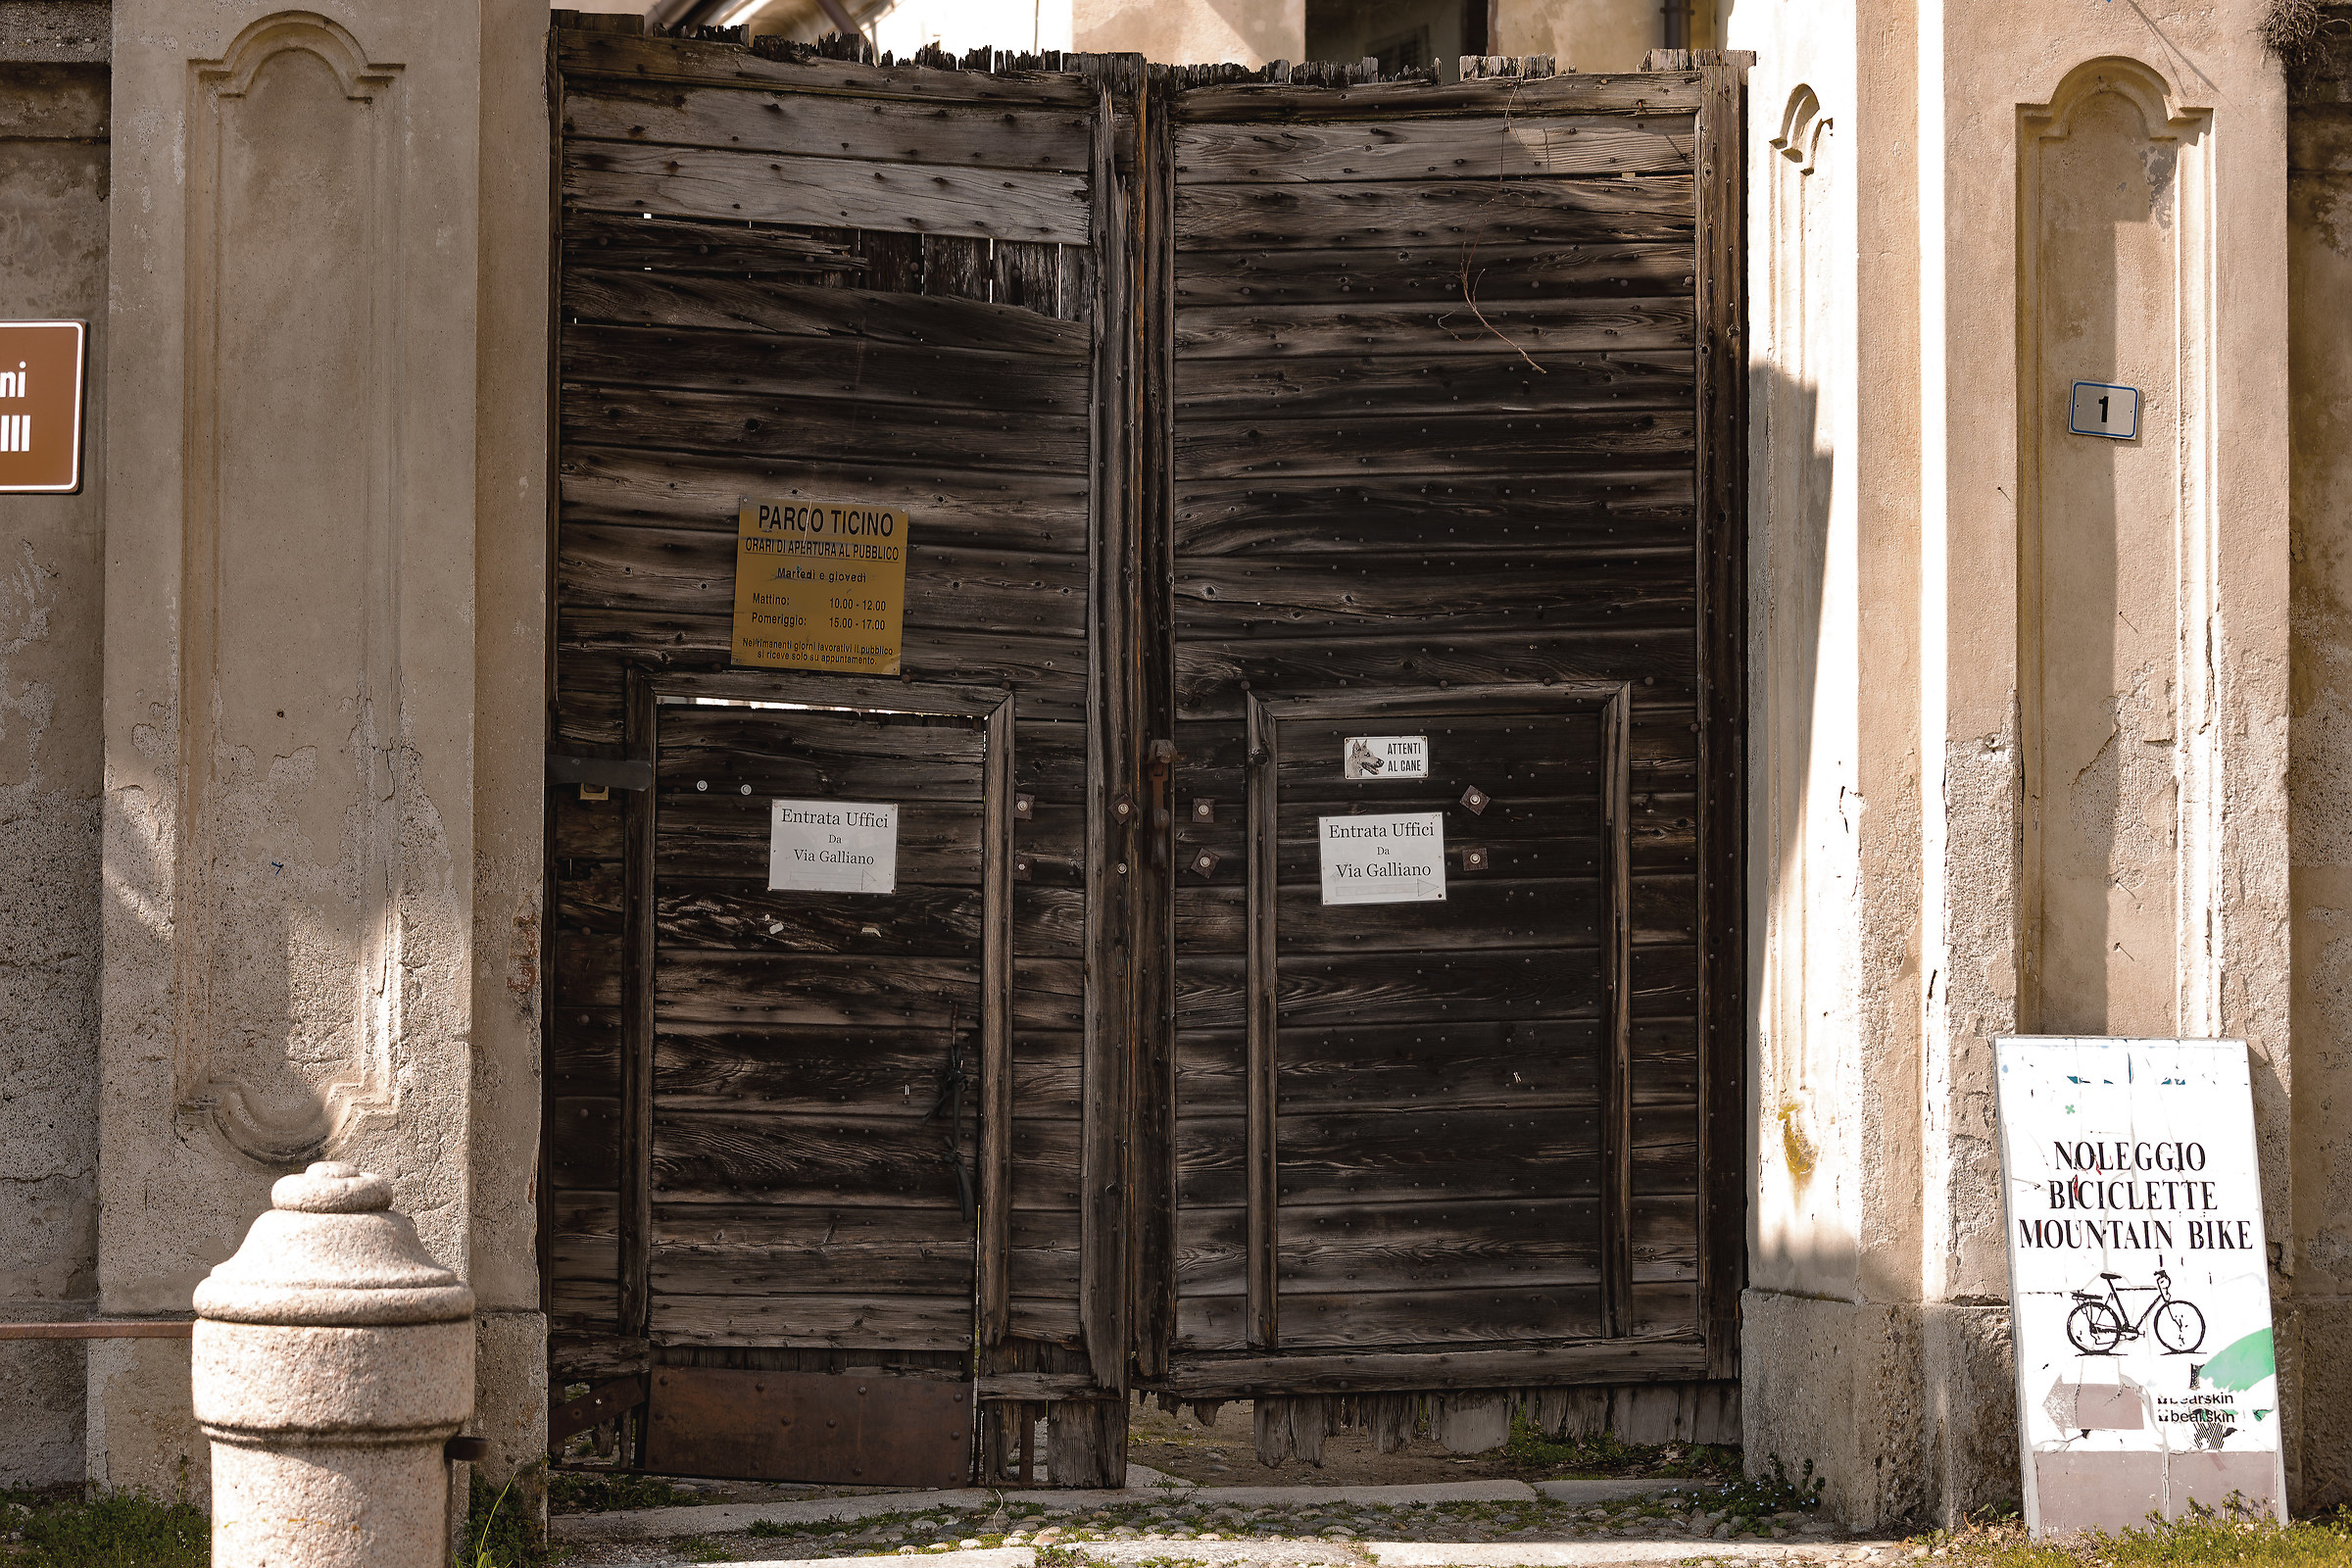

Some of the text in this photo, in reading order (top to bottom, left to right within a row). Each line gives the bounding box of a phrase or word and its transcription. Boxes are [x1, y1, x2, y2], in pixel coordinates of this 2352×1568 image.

[2098, 395, 2109, 423] 1
[759, 505, 894, 537] PARCO TICINO
[745, 537, 900, 561] ORARI DI APERTURA AL PUBBLICO
[828, 571, 866, 583] giovedì
[752, 593, 790, 606] Mattino:
[829, 598, 854, 610] 10.00
[862, 600, 886, 612] 12.00
[752, 612, 807, 627] Pomeriggio:
[829, 617, 853, 629] 15.00
[861, 619, 885, 631] 17.00
[757, 640, 792, 650] rimanenti
[794, 642, 815, 652] giorni
[817, 643, 853, 653] lavorativi
[860, 645, 893, 656] pubblico
[758, 650, 764, 659] si
[766, 652, 789, 661] riceve
[791, 653, 808, 662] solo
[821, 655, 877, 665] appuntamento.
[1387, 743, 1421, 756] ATTENTI
[1388, 760, 1421, 772] AL CANE
[781, 808, 889, 828] Entrata Uffici
[828, 834, 842, 844] Da
[1329, 821, 1435, 839] Entrata Uffici
[794, 849, 874, 865] Via Galliano
[1377, 847, 1390, 856] Da
[1336, 862, 1432, 878] Via Galliano
[2053, 1141, 2206, 1171] NOLEGGIO
[2047, 1179, 2219, 1210] BICICLETTE
[2019, 1218, 2253, 1250] MOUNTAIN BIKE
